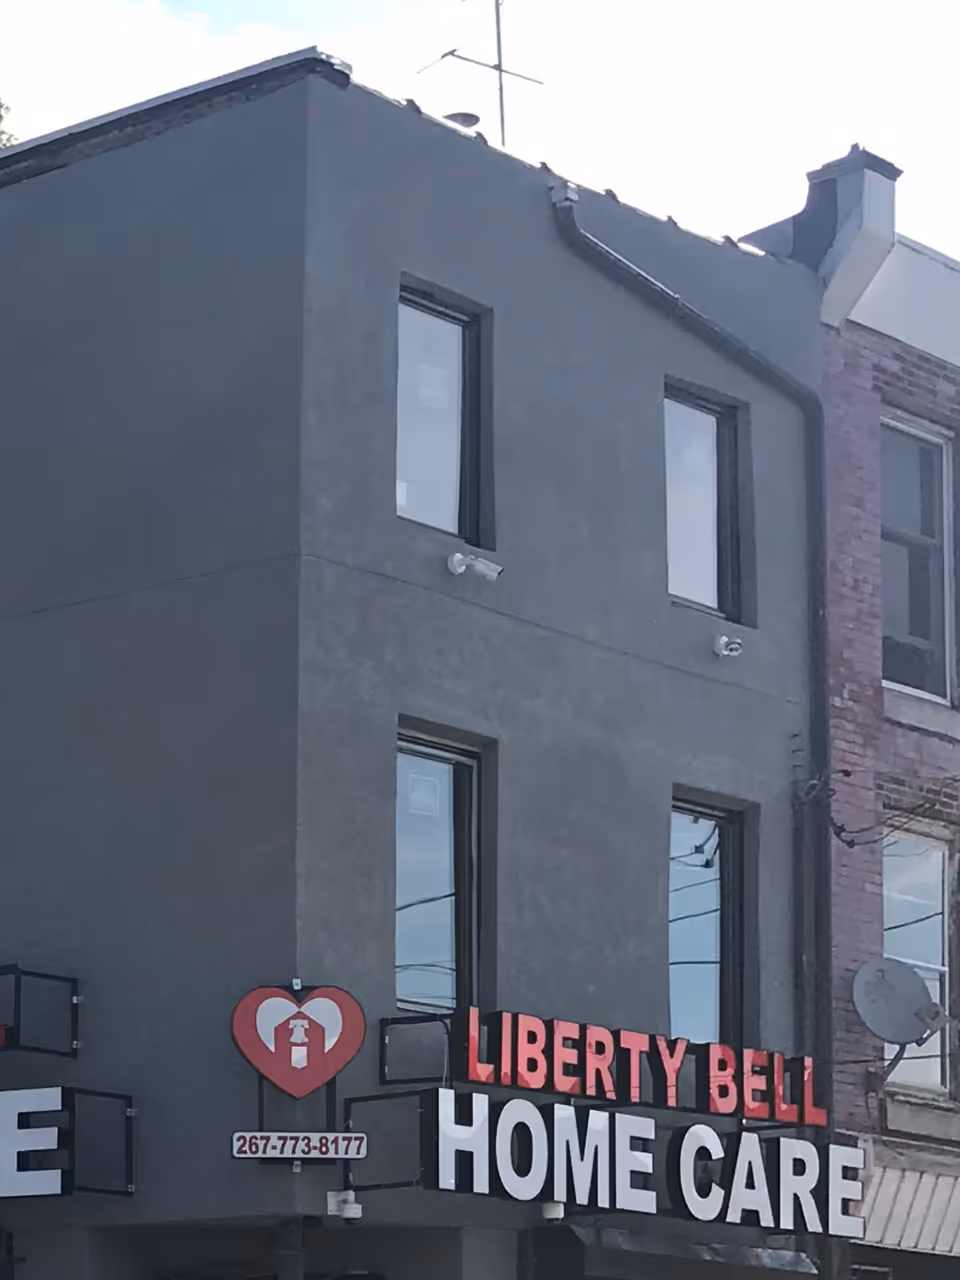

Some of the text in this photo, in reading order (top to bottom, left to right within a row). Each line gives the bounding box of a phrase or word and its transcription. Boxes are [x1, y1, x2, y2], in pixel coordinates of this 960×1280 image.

[467, 1006, 828, 1127] LIBERTY BELL
[236, 1135, 365, 1156] 267-773-8177
[439, 1087, 866, 1238] HOME CARE
